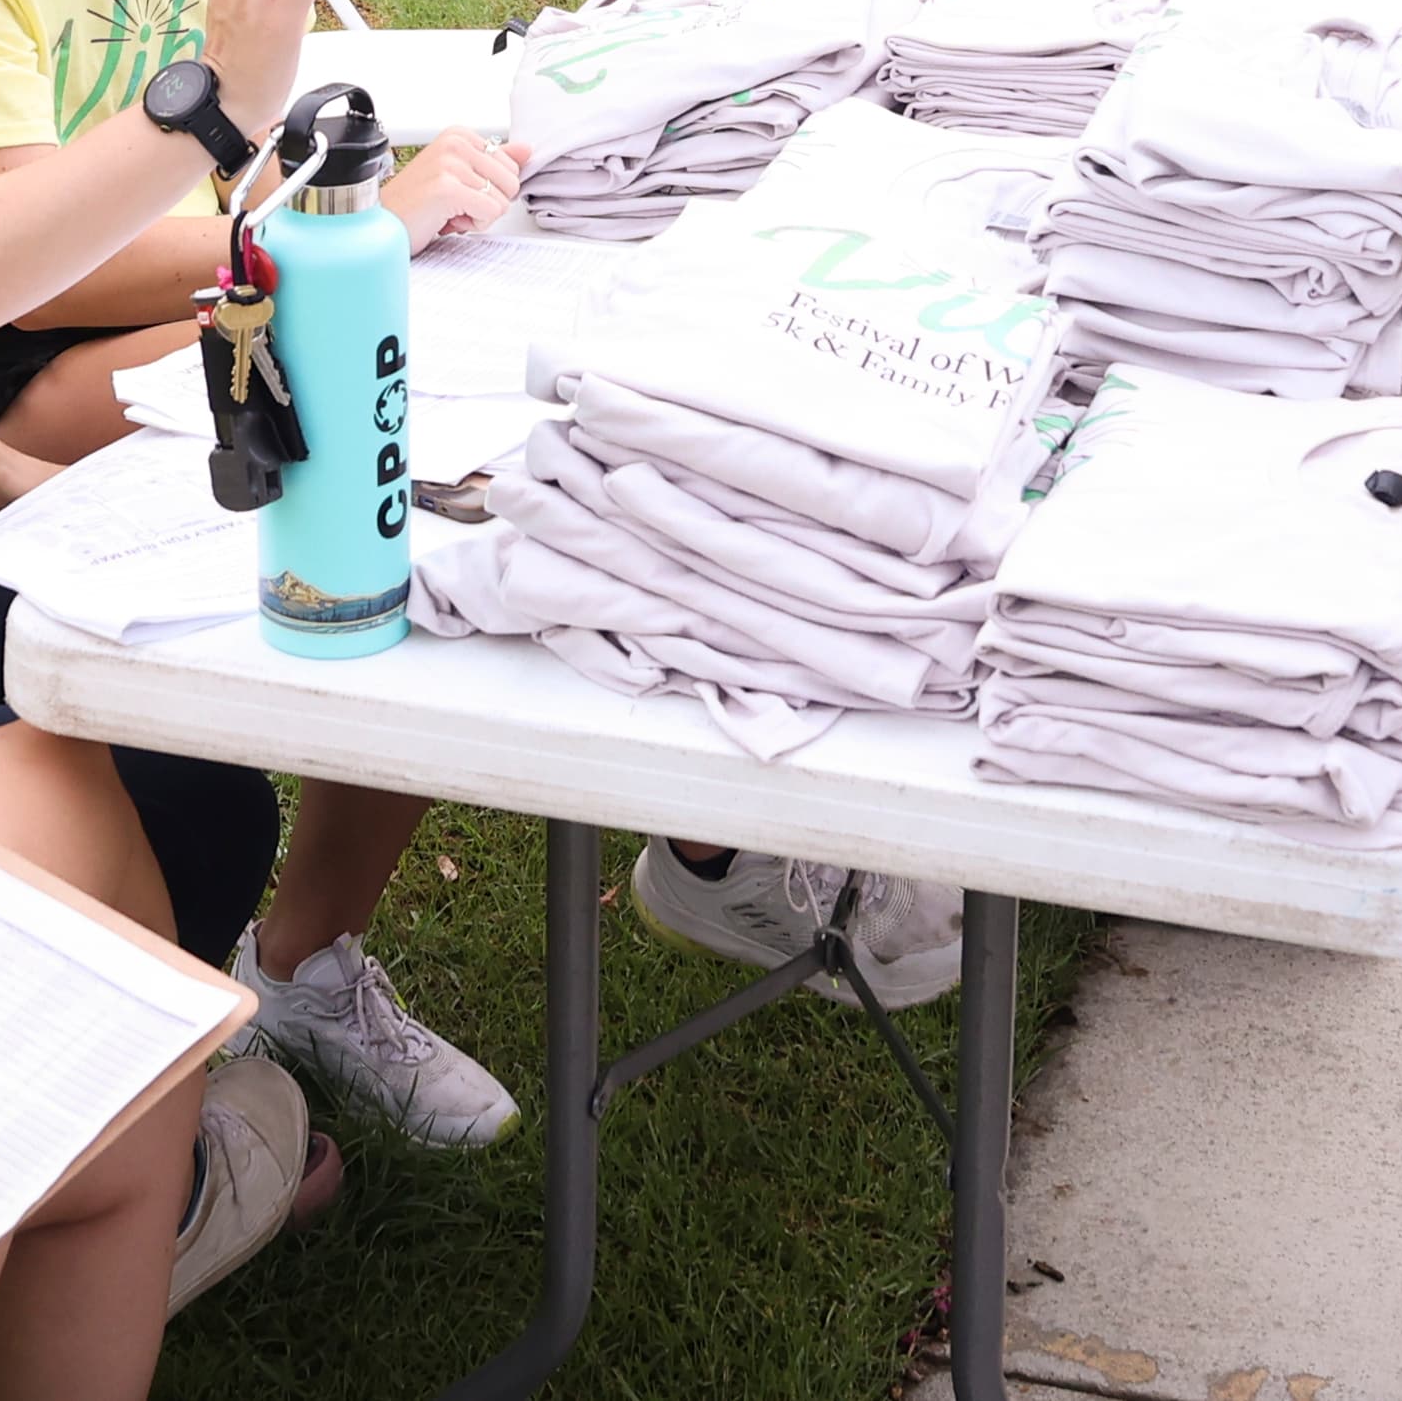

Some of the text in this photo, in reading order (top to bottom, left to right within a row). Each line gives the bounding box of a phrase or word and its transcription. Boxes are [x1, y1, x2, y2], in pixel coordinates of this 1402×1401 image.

[761, 310, 804, 342] 5k
[813, 331, 850, 360] &
[859, 348, 976, 408] Family
[788, 291, 921, 362] Festival
[930, 352, 978, 376] of
